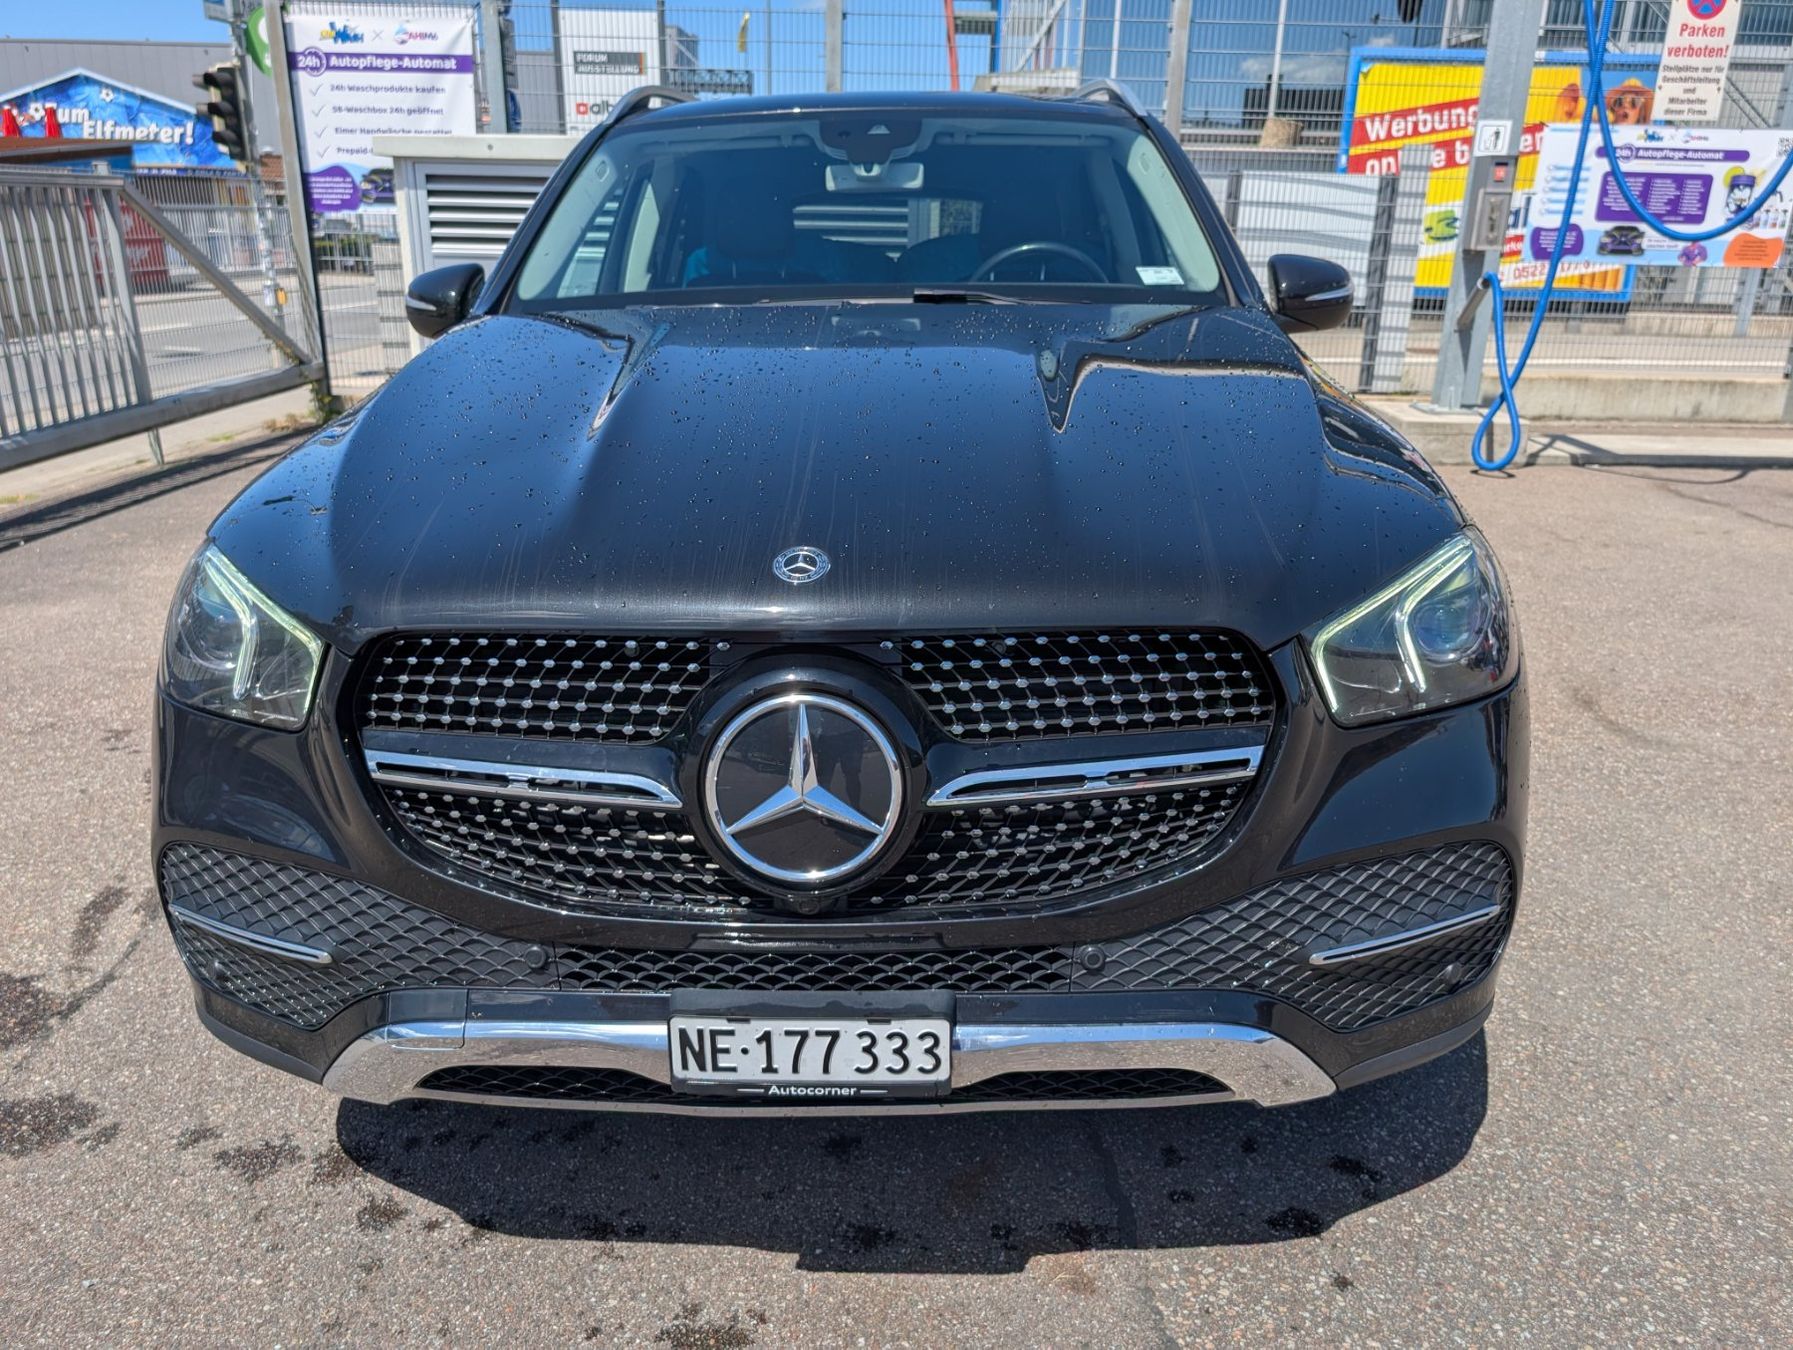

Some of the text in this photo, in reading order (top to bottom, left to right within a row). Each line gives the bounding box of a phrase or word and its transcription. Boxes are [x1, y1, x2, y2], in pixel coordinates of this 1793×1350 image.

[1679, 23, 1725, 38] Parken
[576, 53, 608, 62] FORUM
[1667, 45, 1730, 58] verboten!
[298, 55, 457, 71] 24h Autopflege-Automat
[347, 84, 413, 95] Waschprodukte
[83, 119, 194, 145] Elfmeter!
[1637, 149, 1725, 161] Autopflege-Automat
[853, 1029, 942, 1075] 333
[768, 1084, 857, 1097] Autocorner
